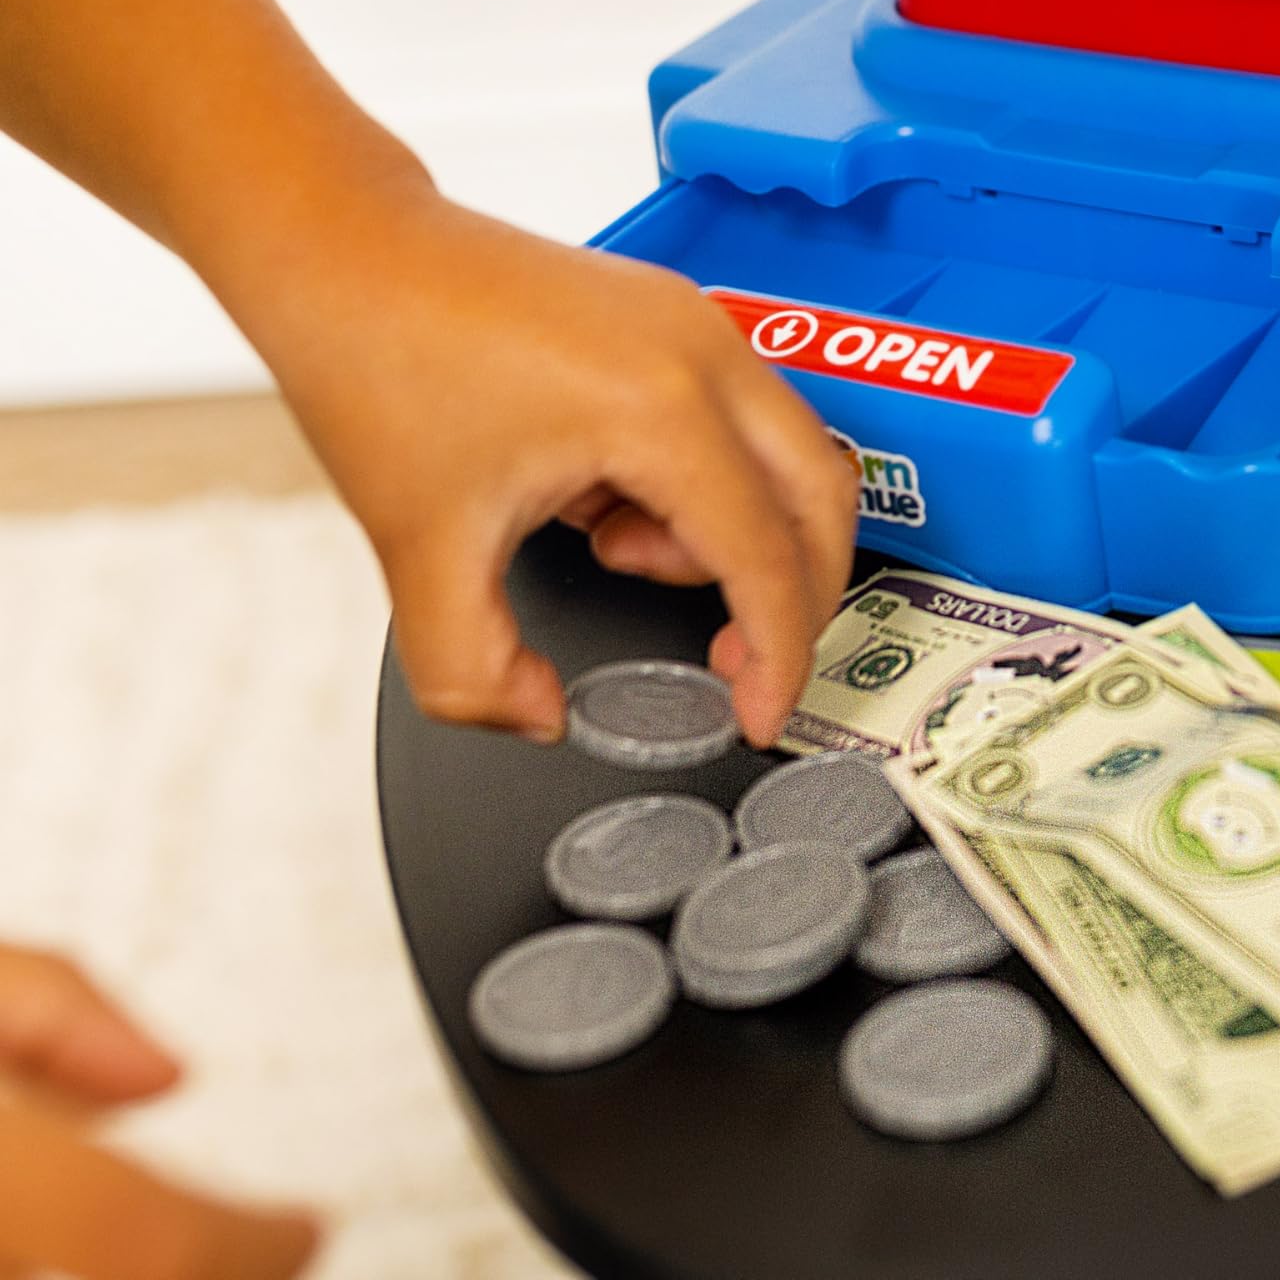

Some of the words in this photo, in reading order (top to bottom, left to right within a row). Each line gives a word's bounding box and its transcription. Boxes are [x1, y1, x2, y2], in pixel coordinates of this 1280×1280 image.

[823, 325, 995, 392] OPEN
[854, 593, 900, 620] 50
[926, 591, 1031, 633] DOLLARS
